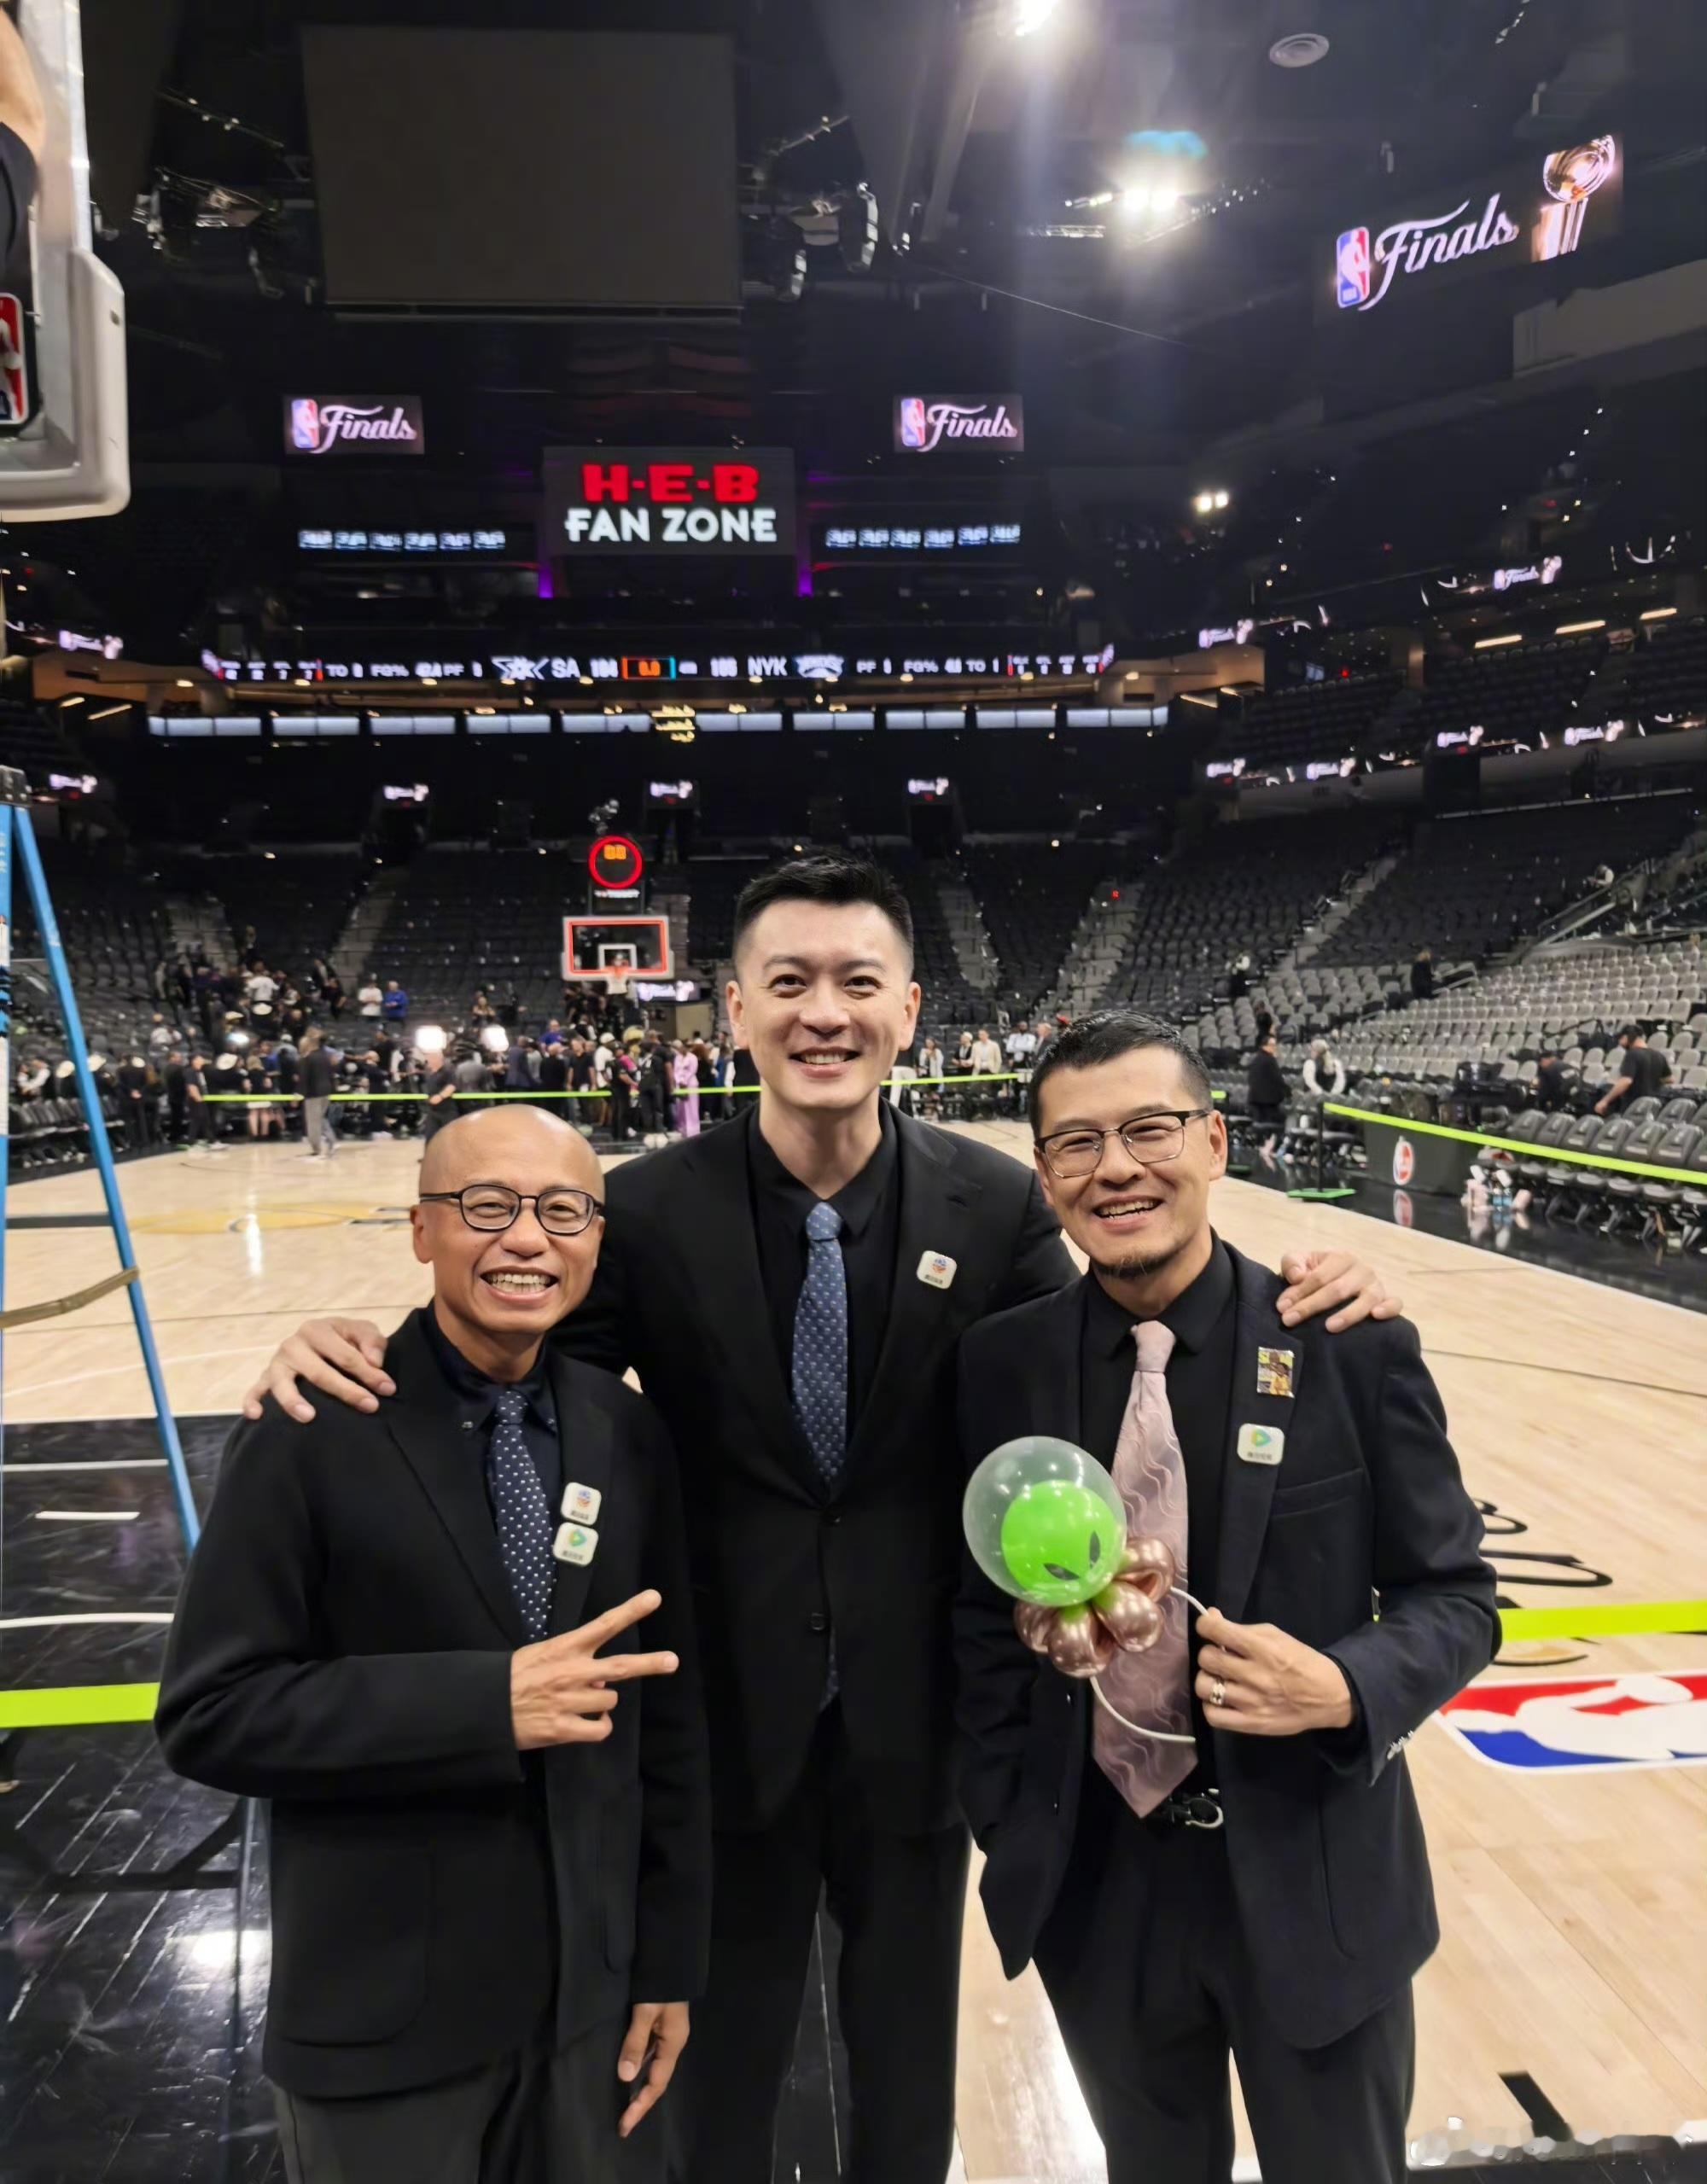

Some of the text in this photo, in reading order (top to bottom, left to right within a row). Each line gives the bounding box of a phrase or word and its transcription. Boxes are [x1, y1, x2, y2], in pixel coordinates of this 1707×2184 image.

[1358, 193, 1519, 311] Finals
[309, 405, 417, 454] Finals
[917, 405, 1017, 452] Finals
[582, 463, 760, 502] H-E-B
[564, 508, 778, 542] FAN ZONE
[551, 657, 580, 678] SA
[747, 655, 788, 677] NYK
[856, 659, 877, 673] PF
[903, 659, 939, 673] FG%
[965, 659, 987, 673] TO
